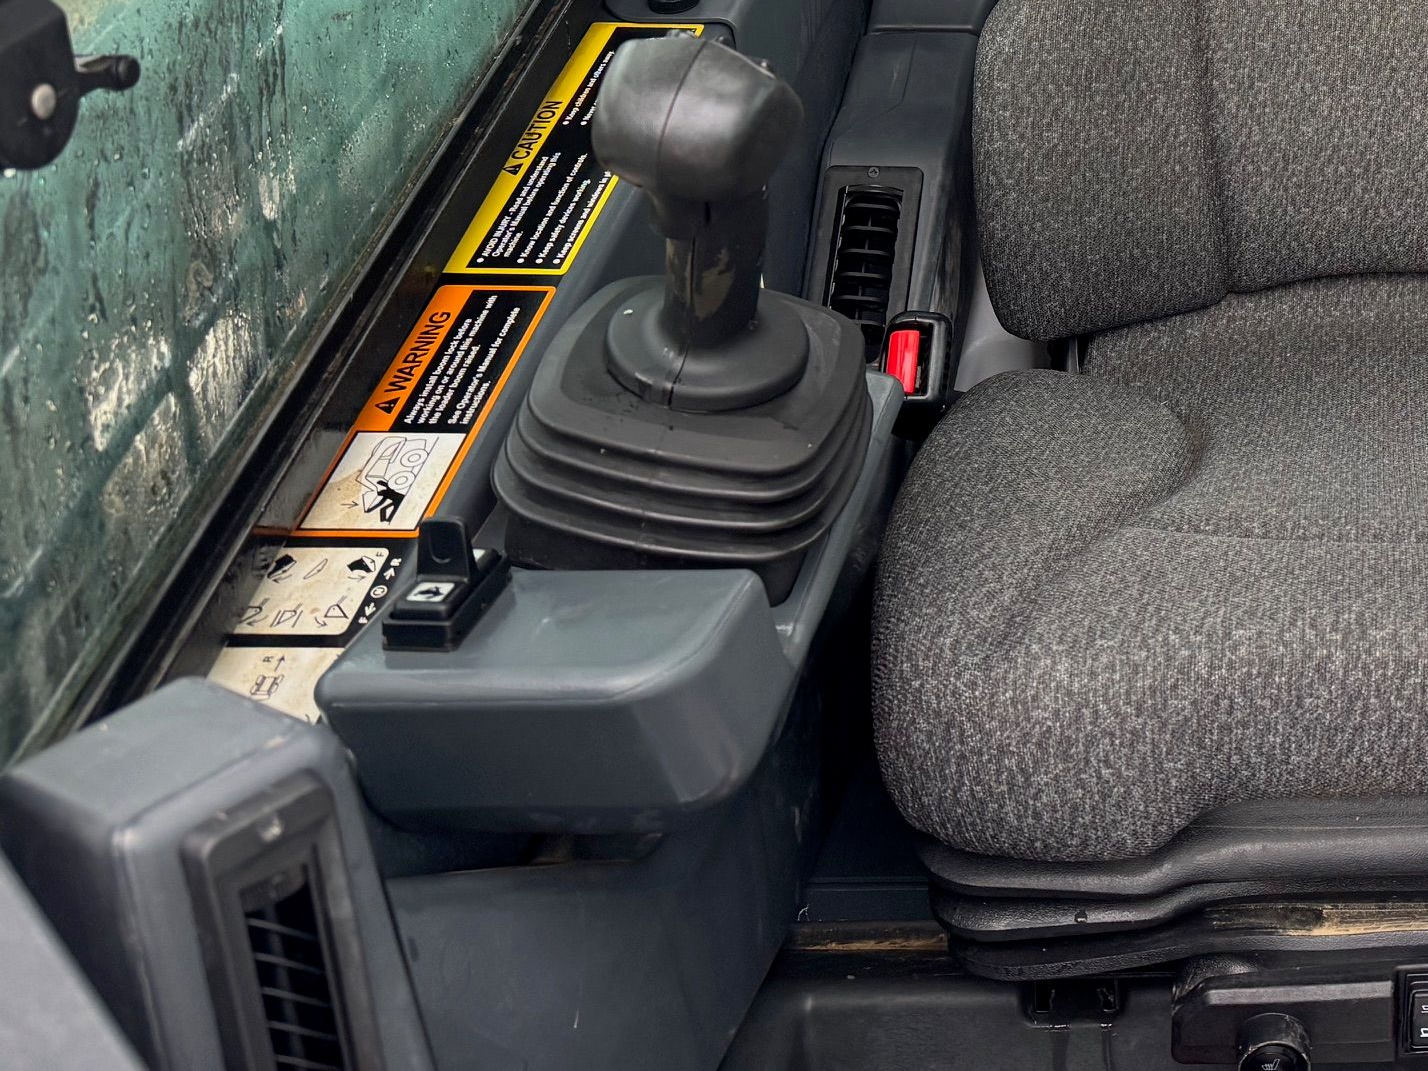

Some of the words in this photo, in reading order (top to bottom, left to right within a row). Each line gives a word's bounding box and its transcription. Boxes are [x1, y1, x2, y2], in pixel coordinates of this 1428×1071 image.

[512, 101, 563, 160] CAUTION
[481, 237, 498, 257] AVOID
[493, 215, 511, 237] INJURY
[508, 197, 523, 212] Read
[526, 156, 549, 186] understand
[491, 227, 515, 257] Operator's
[510, 206, 528, 226] Manual
[522, 188, 539, 206] before
[535, 162, 556, 188] operating
[529, 217, 550, 240] location
[538, 242, 554, 258] Keep
[558, 202, 576, 224] devices
[545, 206, 556, 217] and
[550, 183, 570, 205] function
[556, 242, 572, 258] Keep
[567, 219, 584, 242] screens
[580, 208, 591, 219] and
[586, 184, 605, 207] windows
[519, 240, 536, 257] Know
[384, 311, 451, 393] WARNING
[404, 398, 425, 424] Always
[418, 375, 438, 397] install
[432, 355, 450, 375] boom
[444, 340, 461, 354] lock
[453, 318, 472, 340] before
[417, 395, 441, 424] working
[435, 385, 445, 394] on
[446, 351, 465, 375] around
[459, 337, 473, 350] this
[468, 309, 489, 337] machine
[485, 295, 498, 309] with
[428, 412, 441, 424] the
[435, 388, 455, 411] loader
[448, 368, 467, 388] boom
[462, 344, 481, 367] raised.
[447, 410, 462, 424] See
[456, 373, 483, 409] Operator's
[476, 348, 497, 372] Manual
[491, 337, 503, 347] for
[499, 307, 520, 336] complete
[459, 380, 491, 424] instructions.
